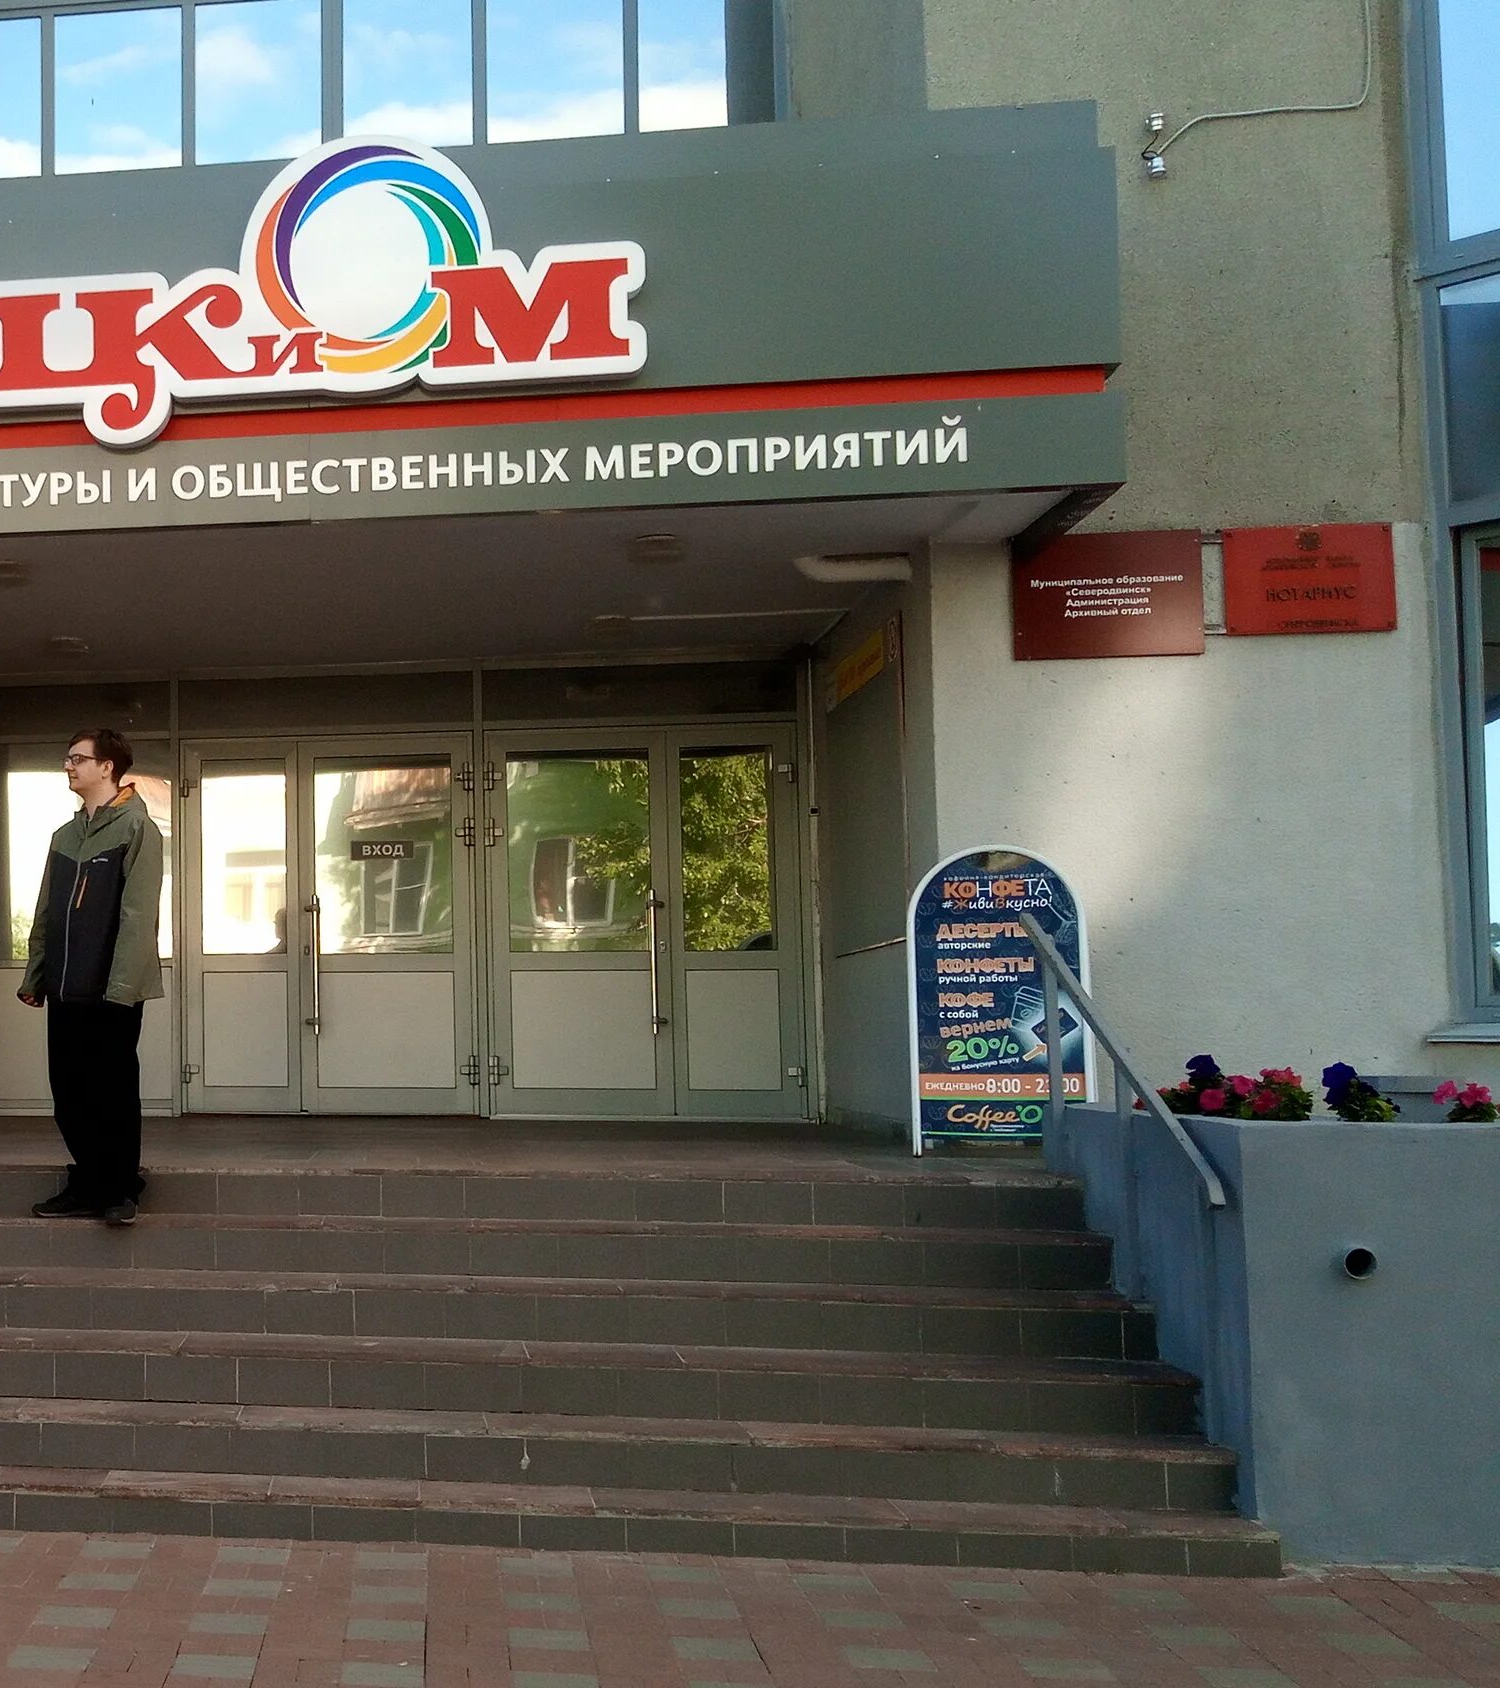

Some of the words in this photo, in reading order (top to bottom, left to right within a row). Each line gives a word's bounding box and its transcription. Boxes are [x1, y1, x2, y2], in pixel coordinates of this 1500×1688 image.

[128, 468, 155, 502] И
[171, 447, 570, 500] ОБЩЕСТВЕННЫХ
[585, 415, 968, 481] МЕРОПРИЯТИЙ
[1030, 577, 1113, 590] Муниципальное
[1116, 573, 1184, 586] образование
[1065, 586, 1152, 597] «Северодвинск»
[1065, 596, 1149, 607] Администрация
[1064, 607, 1118, 618] Архивный
[1120, 607, 1152, 617] отдел
[362, 844, 405, 857] ВХОД
[943, 878, 1053, 899] КОНФЕТА
[937, 941, 991, 951] авторские
[936, 956, 1035, 974] КОНФЕТЫ
[938, 973, 977, 985] ручной
[979, 974, 1018, 984] работы
[938, 991, 995, 1008] КОФЕ
[939, 1011, 945, 1019] с
[947, 1009, 979, 1019] собой
[939, 1017, 1013, 1039] вернем
[946, 1035, 1020, 1063] 20%
[925, 1081, 986, 1092] ЕЖЕДНЕВНО
